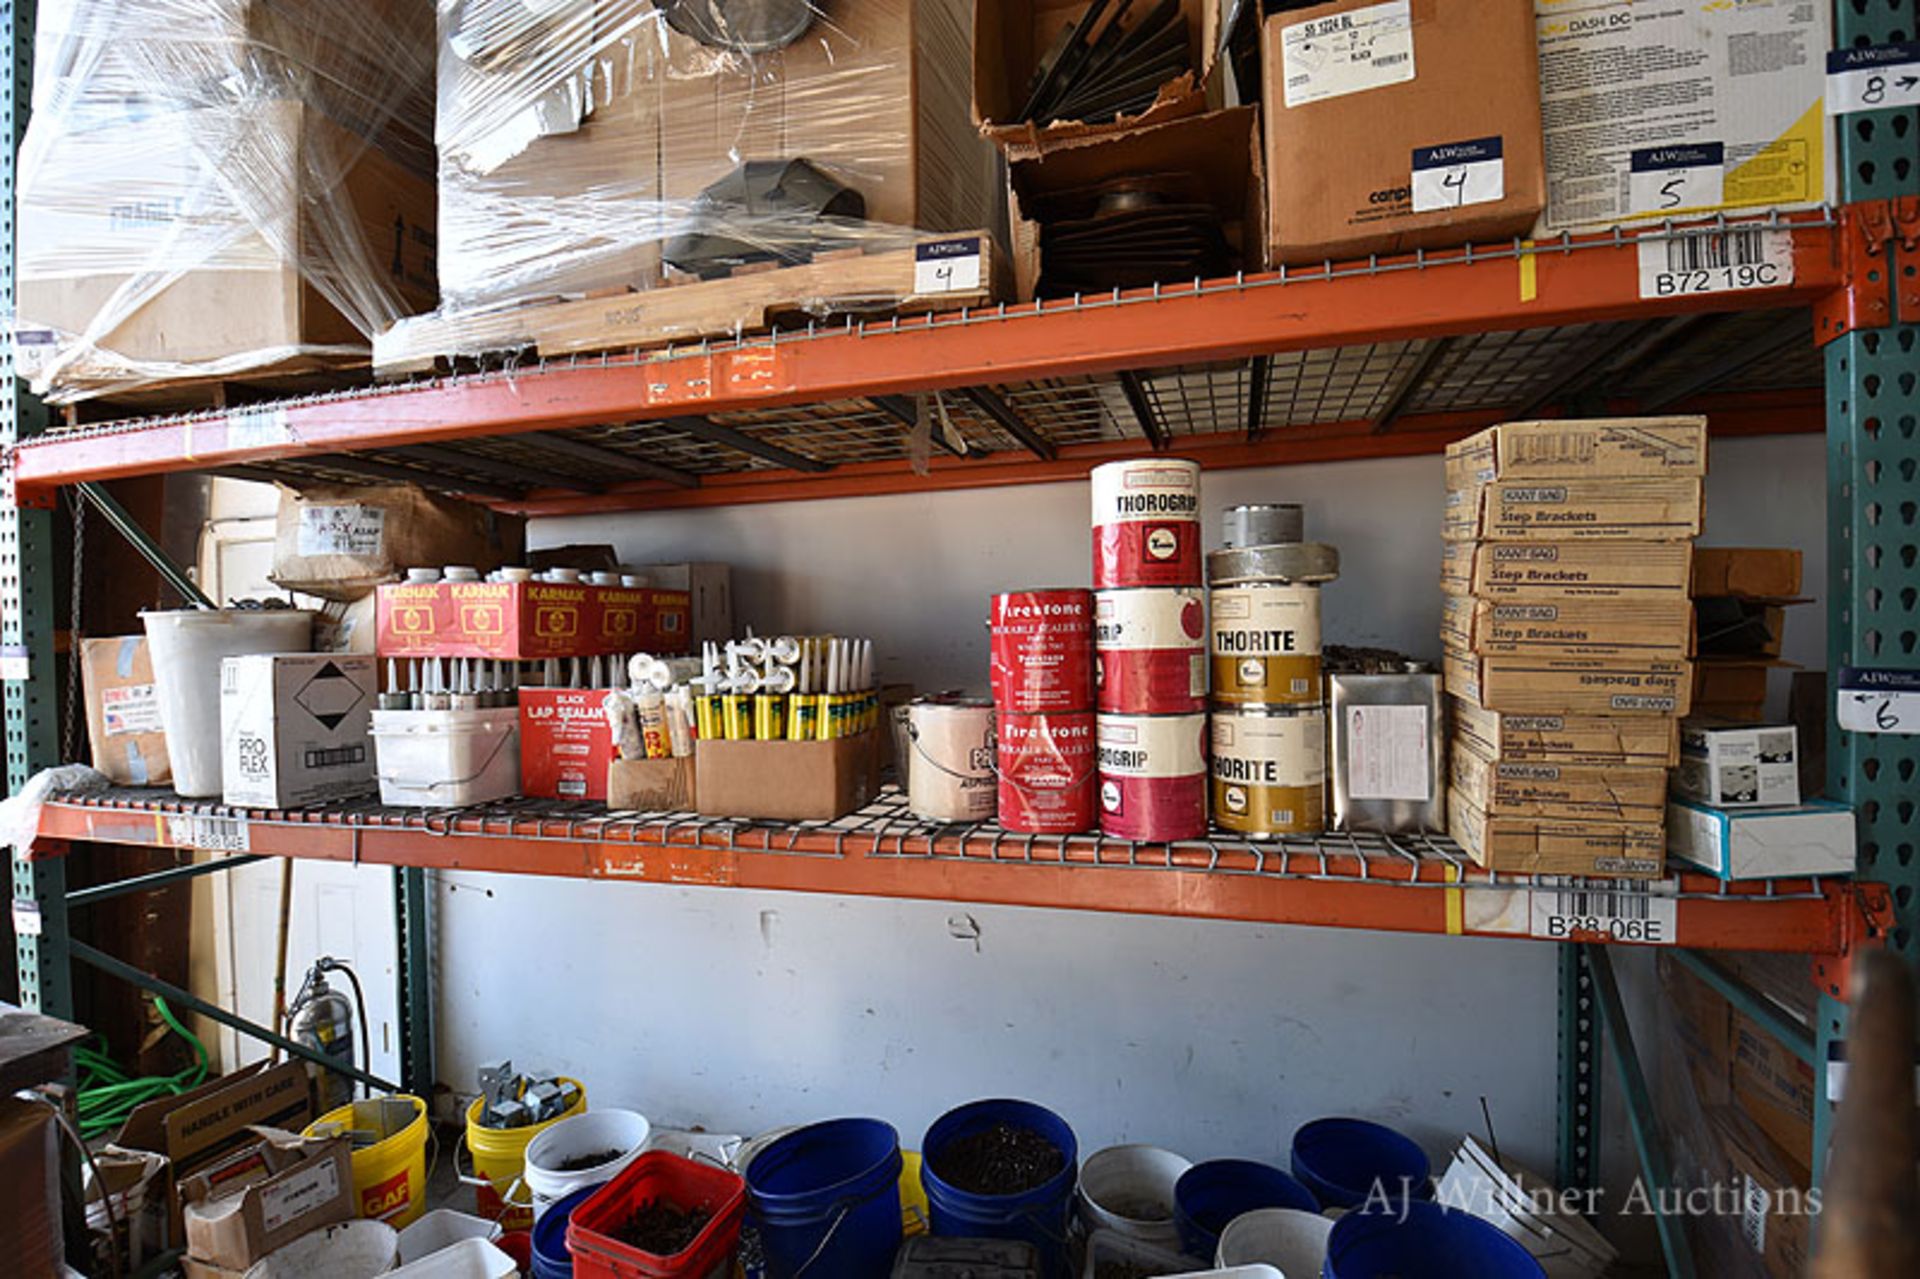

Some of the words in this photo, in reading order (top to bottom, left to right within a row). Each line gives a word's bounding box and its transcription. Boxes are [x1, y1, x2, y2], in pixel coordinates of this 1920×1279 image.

[1568, 17, 1607, 32] DASH
[1609, 11, 1631, 26] DC
[1862, 76, 1885, 104] 8
[1443, 171, 1468, 205] 4
[936, 266, 952, 292] 4
[1656, 270, 1711, 295] B72
[1722, 263, 1779, 288] 19C
[1116, 494, 1197, 512] THOROGRIP
[1500, 511, 1532, 524] Step
[1535, 510, 1597, 522] Brackets
[1491, 570, 1522, 582] Step
[1526, 570, 1588, 581] Brackets
[450, 585, 510, 599] KARNAK
[527, 587, 586, 602] KARNAK
[597, 590, 643, 604] KARNAK
[998, 604, 1083, 618] Firestone
[1216, 630, 1296, 651] THORITE
[1491, 628, 1523, 640] Step
[1526, 628, 1589, 640] Brackets
[1579, 675, 1641, 686] Brackets
[1646, 675, 1677, 687] Step
[527, 706, 554, 718] LAP
[1876, 699, 1899, 730] 6
[239, 738, 267, 755] PRO
[239, 755, 269, 773] FLEX
[1609, 919, 1662, 941] 06E
[182, 1106, 231, 1138] HANDLE
[233, 1091, 263, 1112] WITH
[265, 1076, 295, 1100] CARE
[366, 1182, 409, 1216] GAF
